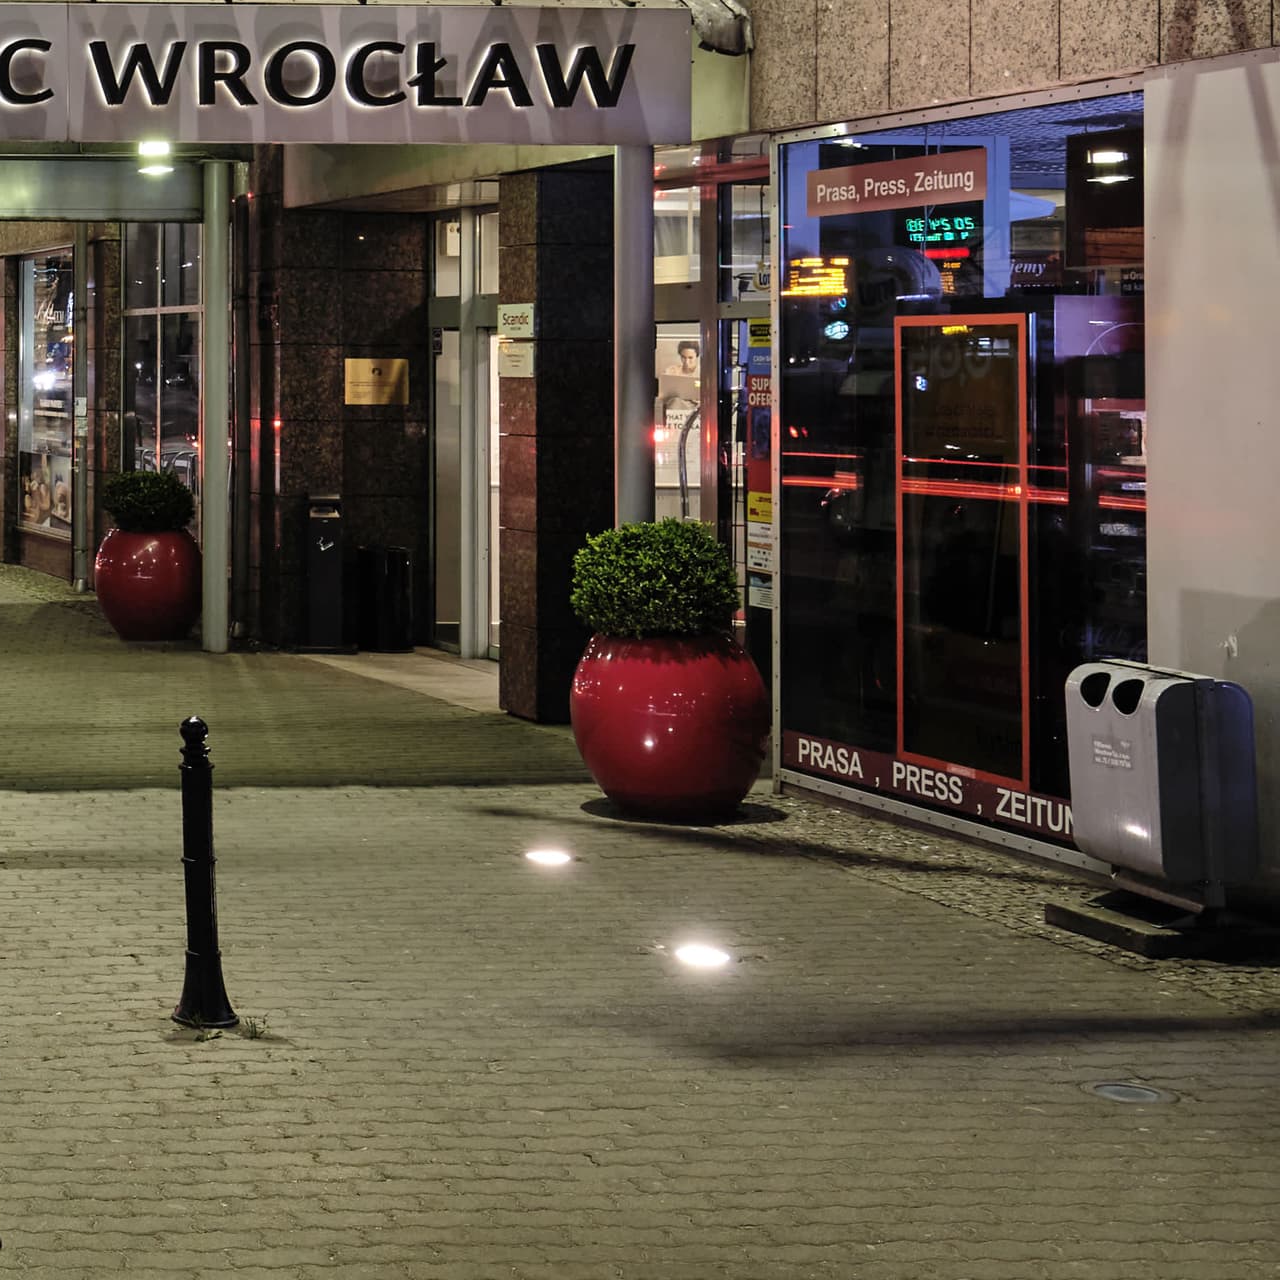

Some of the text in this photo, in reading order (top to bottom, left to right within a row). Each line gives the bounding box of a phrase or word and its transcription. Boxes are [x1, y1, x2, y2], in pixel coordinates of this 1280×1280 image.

[89, 38, 636, 109] WROCŁAW
[816, 170, 975, 203] Prasa, Press, Zeitung
[797, 738, 864, 779] PRASA
[892, 760, 963, 805] PRESS
